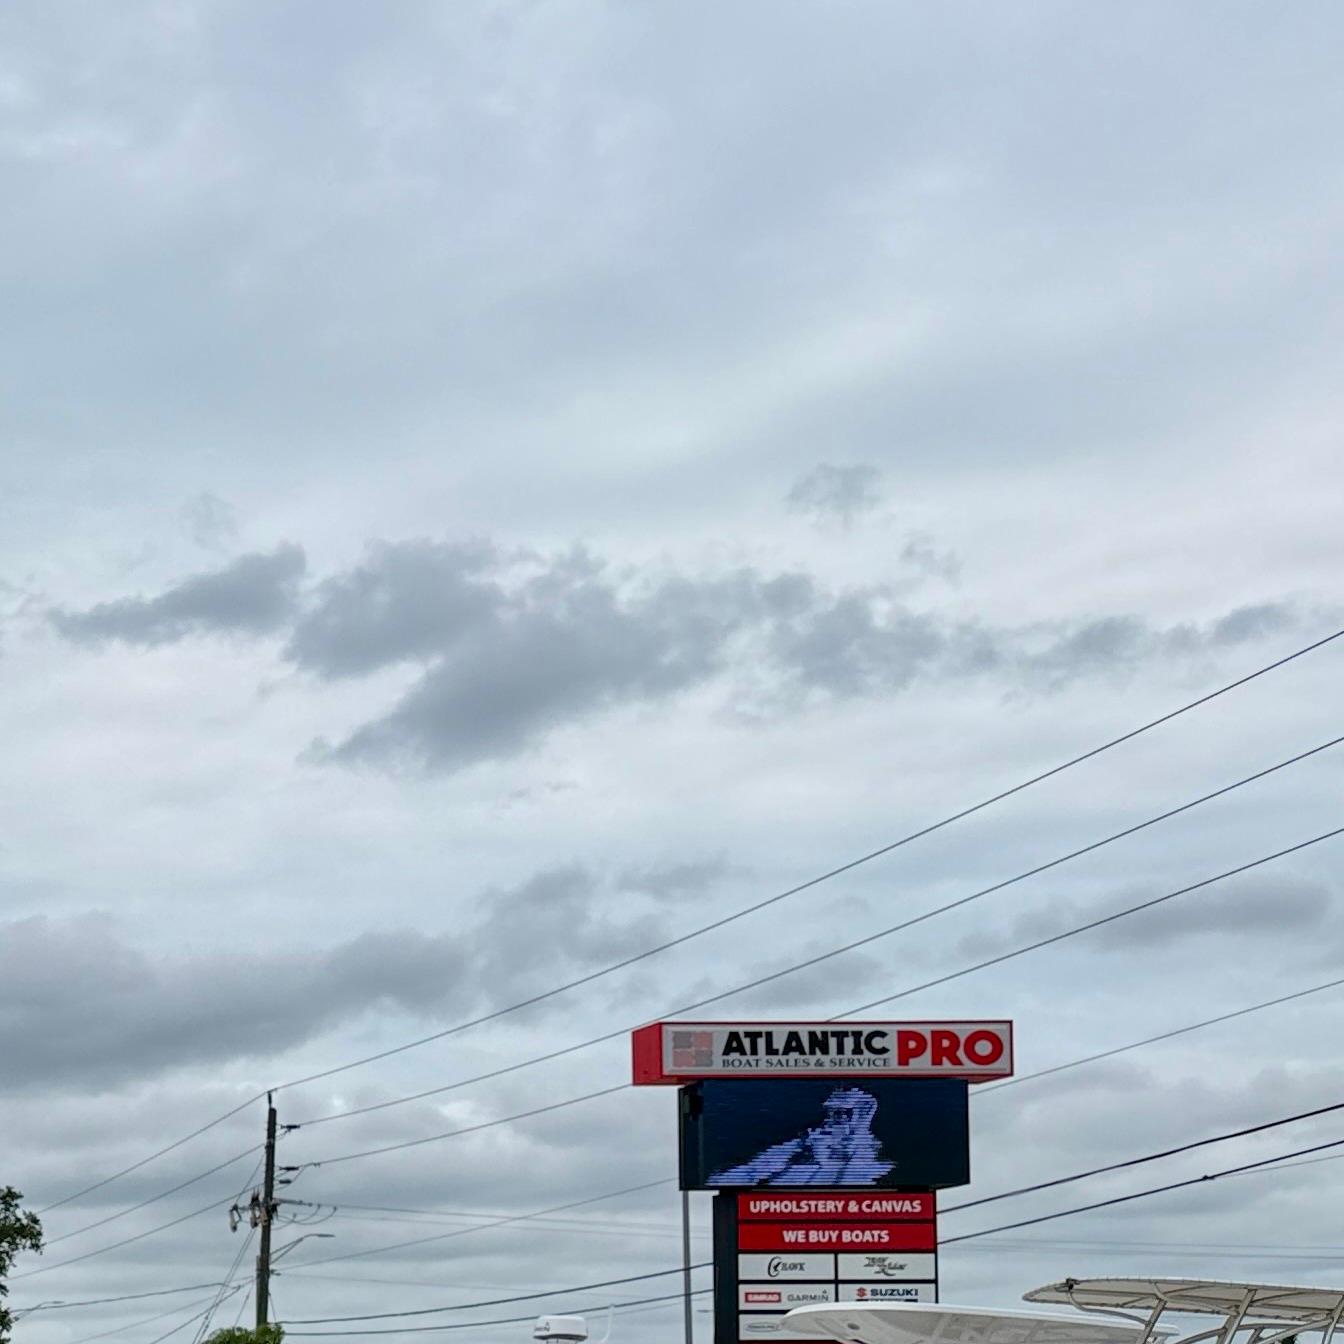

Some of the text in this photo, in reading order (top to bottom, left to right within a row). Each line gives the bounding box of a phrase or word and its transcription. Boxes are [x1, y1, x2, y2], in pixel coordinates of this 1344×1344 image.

[722, 1030, 1004, 1066] ATLANTIC PRO
[722, 1058, 890, 1068] BOAT SALES & SERVICE
[749, 1200, 921, 1213] UPHOLSTERY & CANVAS
[783, 1230, 889, 1243] WE BUY BOATS
[787, 1293, 829, 1301] GARMIN
[870, 1289, 918, 1297] SUZUKI
